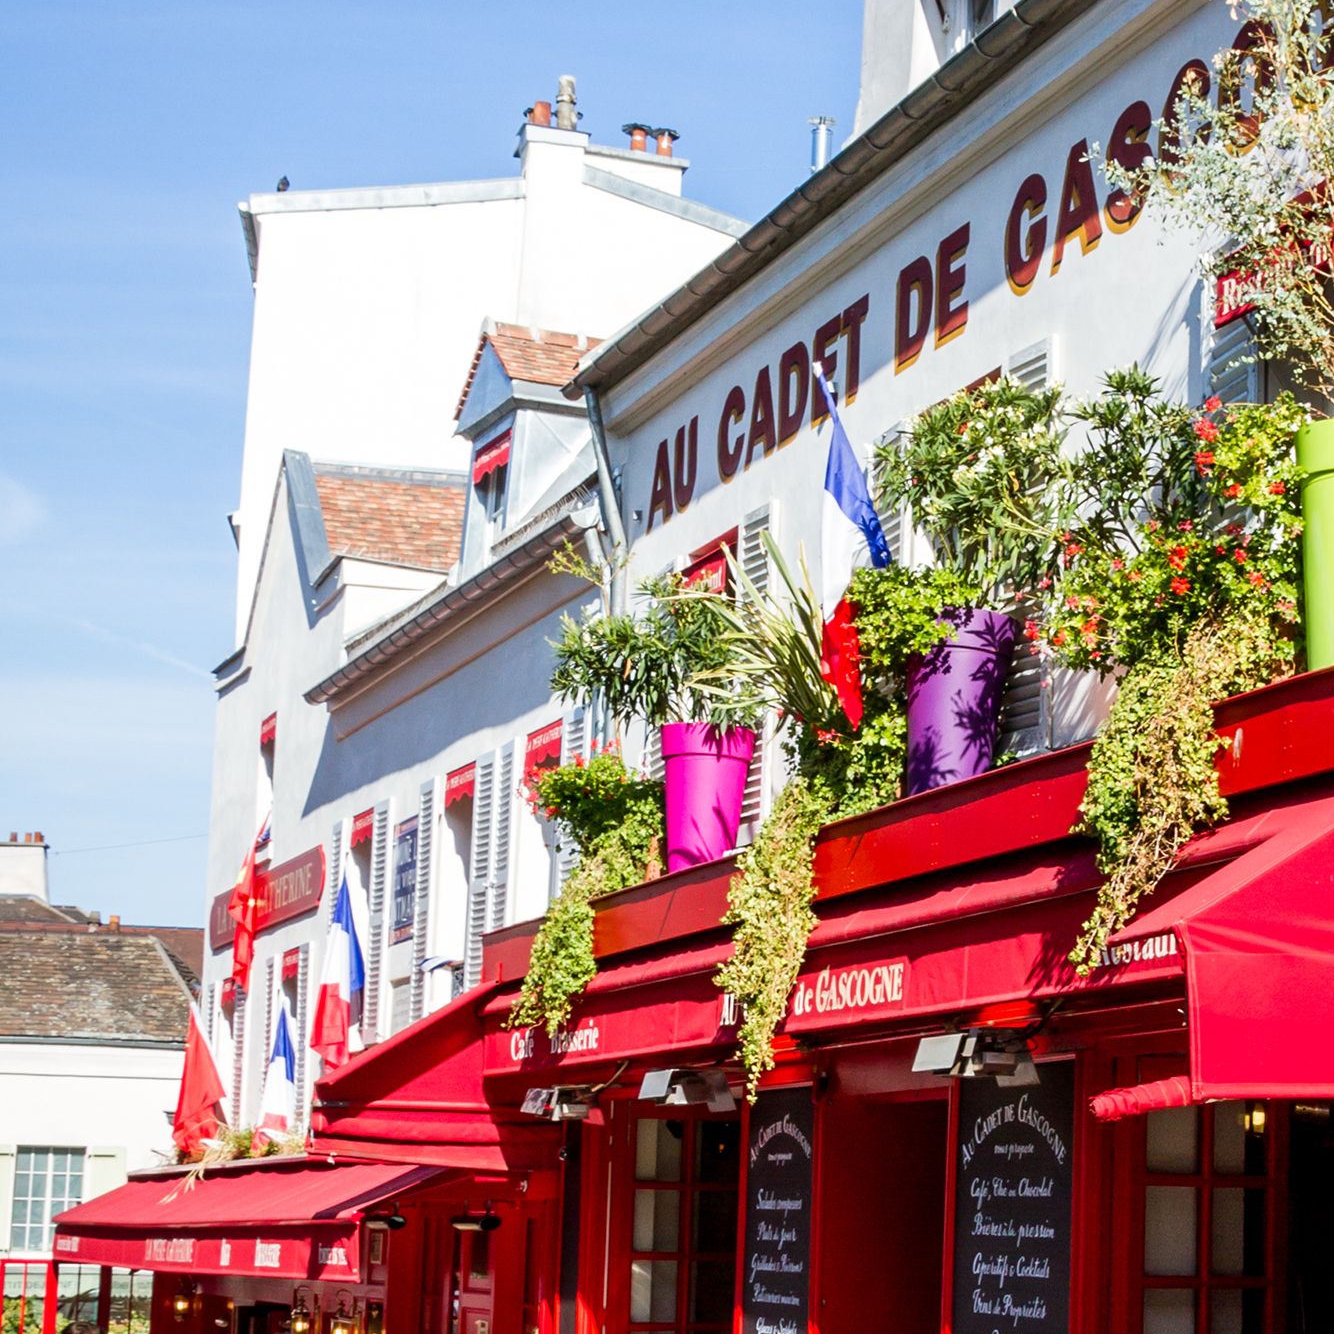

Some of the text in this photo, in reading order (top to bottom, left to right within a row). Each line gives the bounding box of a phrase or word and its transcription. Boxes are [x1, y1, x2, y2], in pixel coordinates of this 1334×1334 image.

[646, 414, 699, 535] AU
[717, 292, 870, 485] CADET
[894, 221, 971, 377] DE
[794, 980, 814, 1015] de
[816, 964, 905, 1013] GASCOGNE
[510, 1029, 535, 1061] Café
[1017, 1093, 1067, 1165] GASCOGNE
[1018, 1176, 1054, 1197] Chocolat
[1017, 1219, 1054, 1247] pression
[1016, 1255, 1050, 1278] Cocktails
